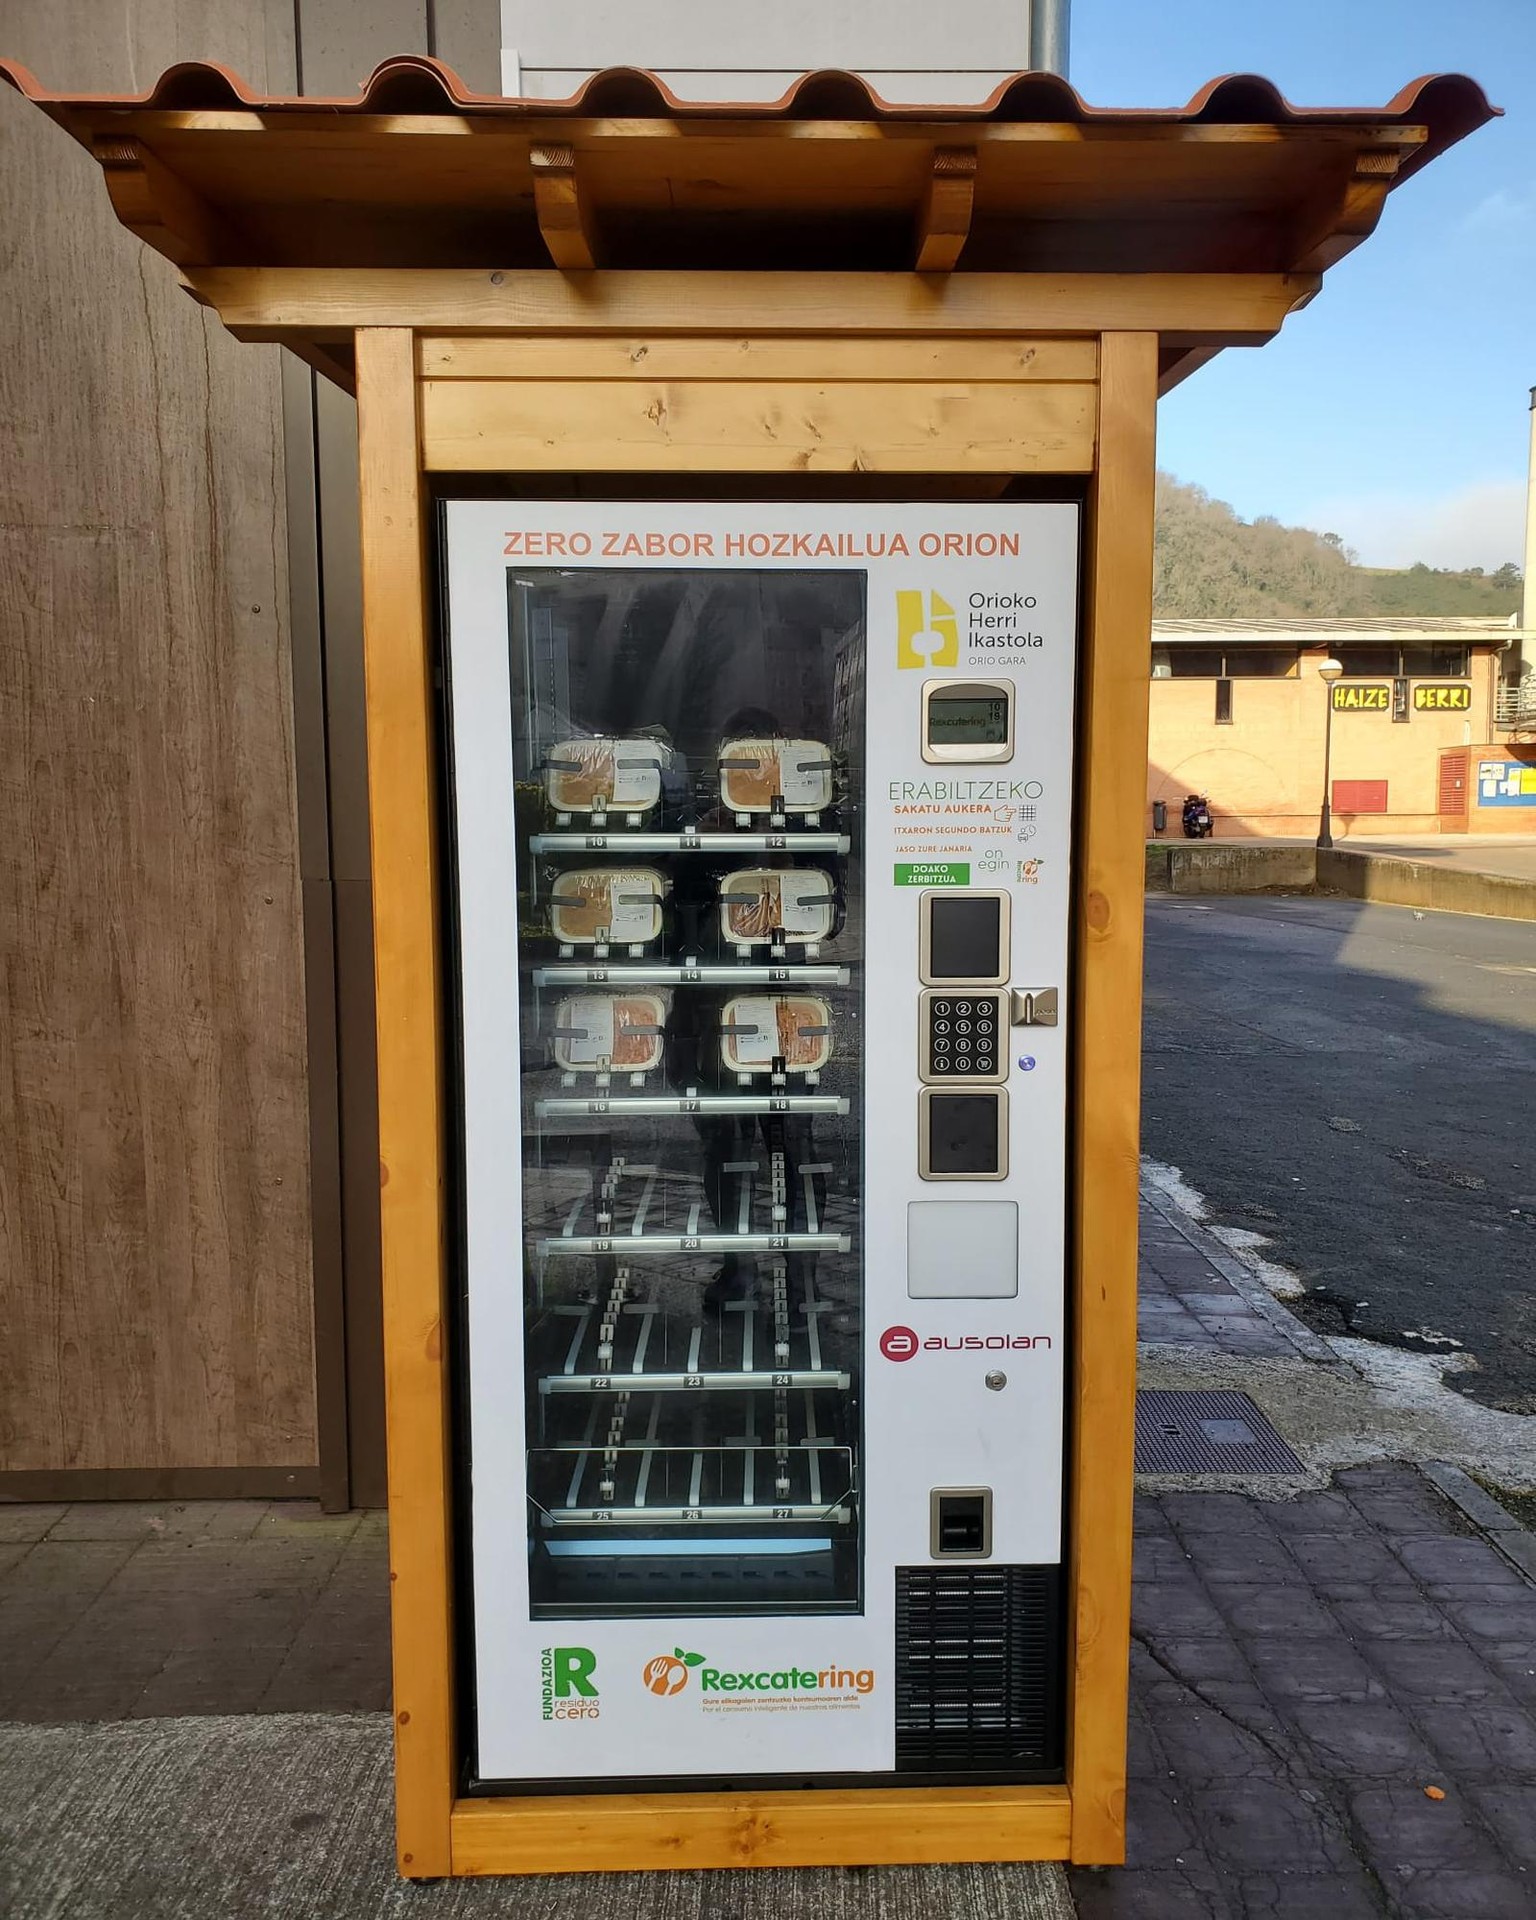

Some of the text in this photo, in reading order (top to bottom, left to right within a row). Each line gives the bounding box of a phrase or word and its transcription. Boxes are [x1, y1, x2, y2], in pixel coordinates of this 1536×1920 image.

[503, 531, 1021, 558] ZERO ZABOR HOZKAILUA ORION
[969, 592, 1037, 609] Orioko
[969, 612, 1017, 628] Herri
[968, 631, 1043, 648] Ikastola
[968, 656, 1026, 666] ORIO GARA
[1334, 688, 1469, 708] HAIZE BERRI
[988, 703, 1001, 711] 10
[888, 781, 1044, 800] ERABILTZEKO
[894, 805, 992, 814] SAKATU AUKERA
[894, 827, 933, 835] ITXARON
[979, 826, 1012, 834] BATZUK
[591, 837, 603, 846] 10
[685, 837, 696, 847] 11
[770, 837, 783, 847] 12
[985, 850, 1003, 859] on
[913, 865, 948, 873] DOAKO
[978, 860, 1009, 872] egin
[907, 875, 956, 883] ZERBITZUA
[592, 972, 604, 981] 13
[686, 971, 697, 980] 14
[774, 970, 786, 979] 15
[593, 1103, 606, 1112] 16
[686, 1102, 697, 1111] 17
[775, 1101, 787, 1110] 18
[596, 1241, 609, 1250] 19
[685, 1239, 697, 1248] 20
[773, 1238, 784, 1247] 21
[923, 1334, 1051, 1350] ausolan
[595, 1378, 607, 1387] 22
[689, 1377, 701, 1386] 23
[777, 1375, 789, 1384] 24
[687, 1511, 699, 1519] 26
[777, 1510, 789, 1518] 27
[554, 1647, 599, 1697] R
[542, 1647, 553, 1720] FUNDAZIOA
[702, 1665, 874, 1693] Rexcatering
[555, 1699, 600, 1707] residuo
[555, 1708, 599, 1719] cero
